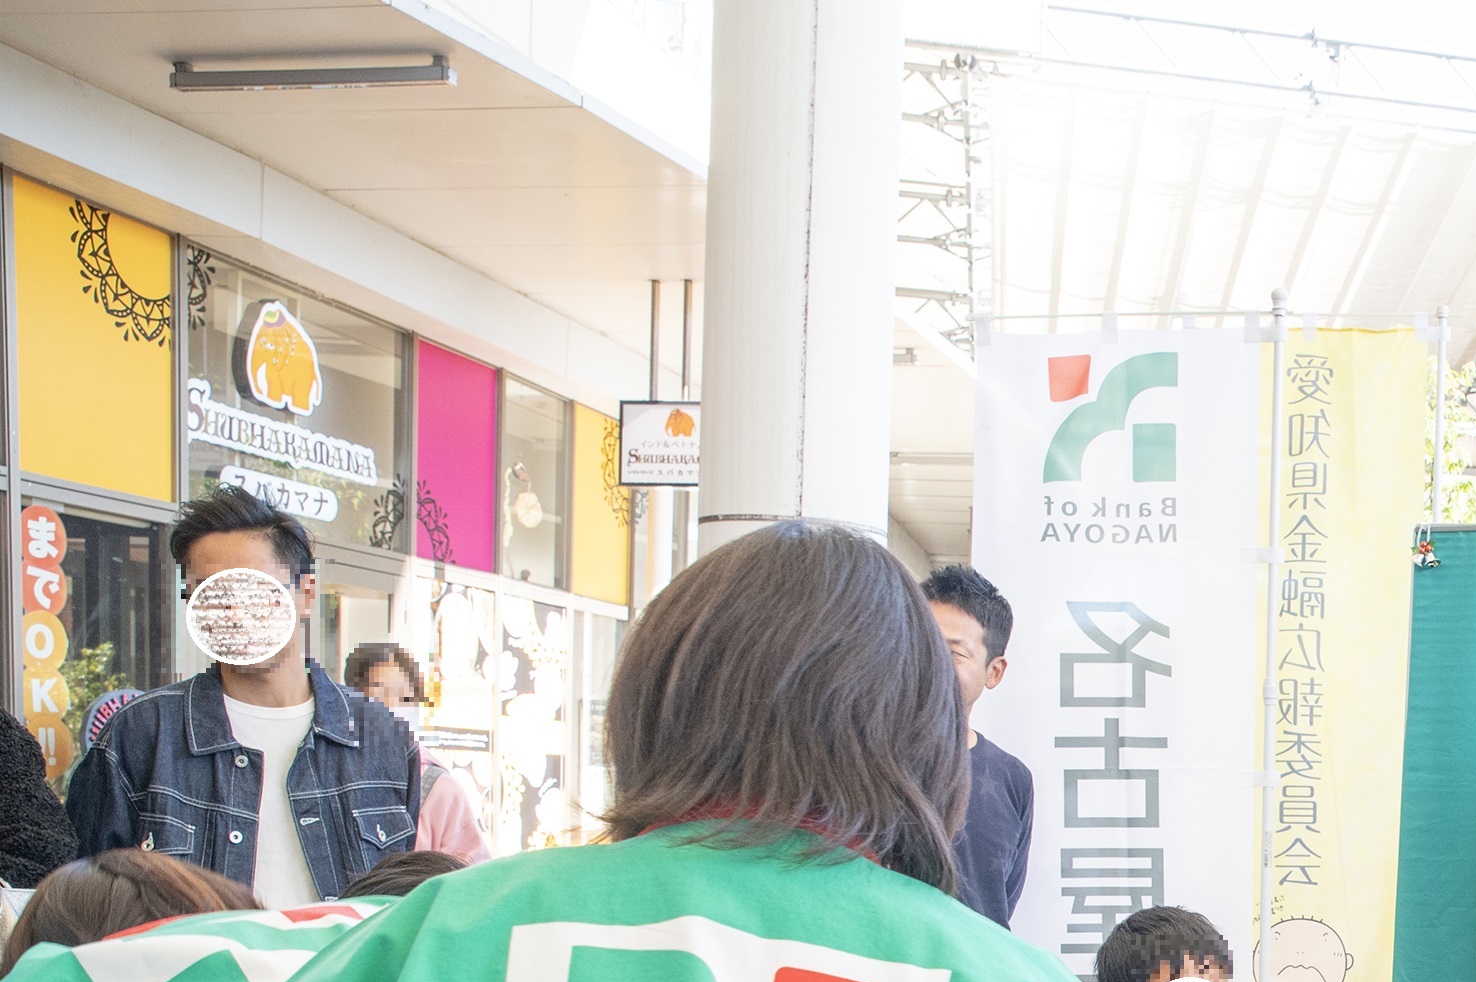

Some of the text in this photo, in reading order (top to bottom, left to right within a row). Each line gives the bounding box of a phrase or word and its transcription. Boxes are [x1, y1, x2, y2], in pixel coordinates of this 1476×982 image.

[641, 440, 700, 449] インド&ベトナ
[626, 448, 700, 466] SHUBHAKA
[657, 468, 700, 476] スバカマ
